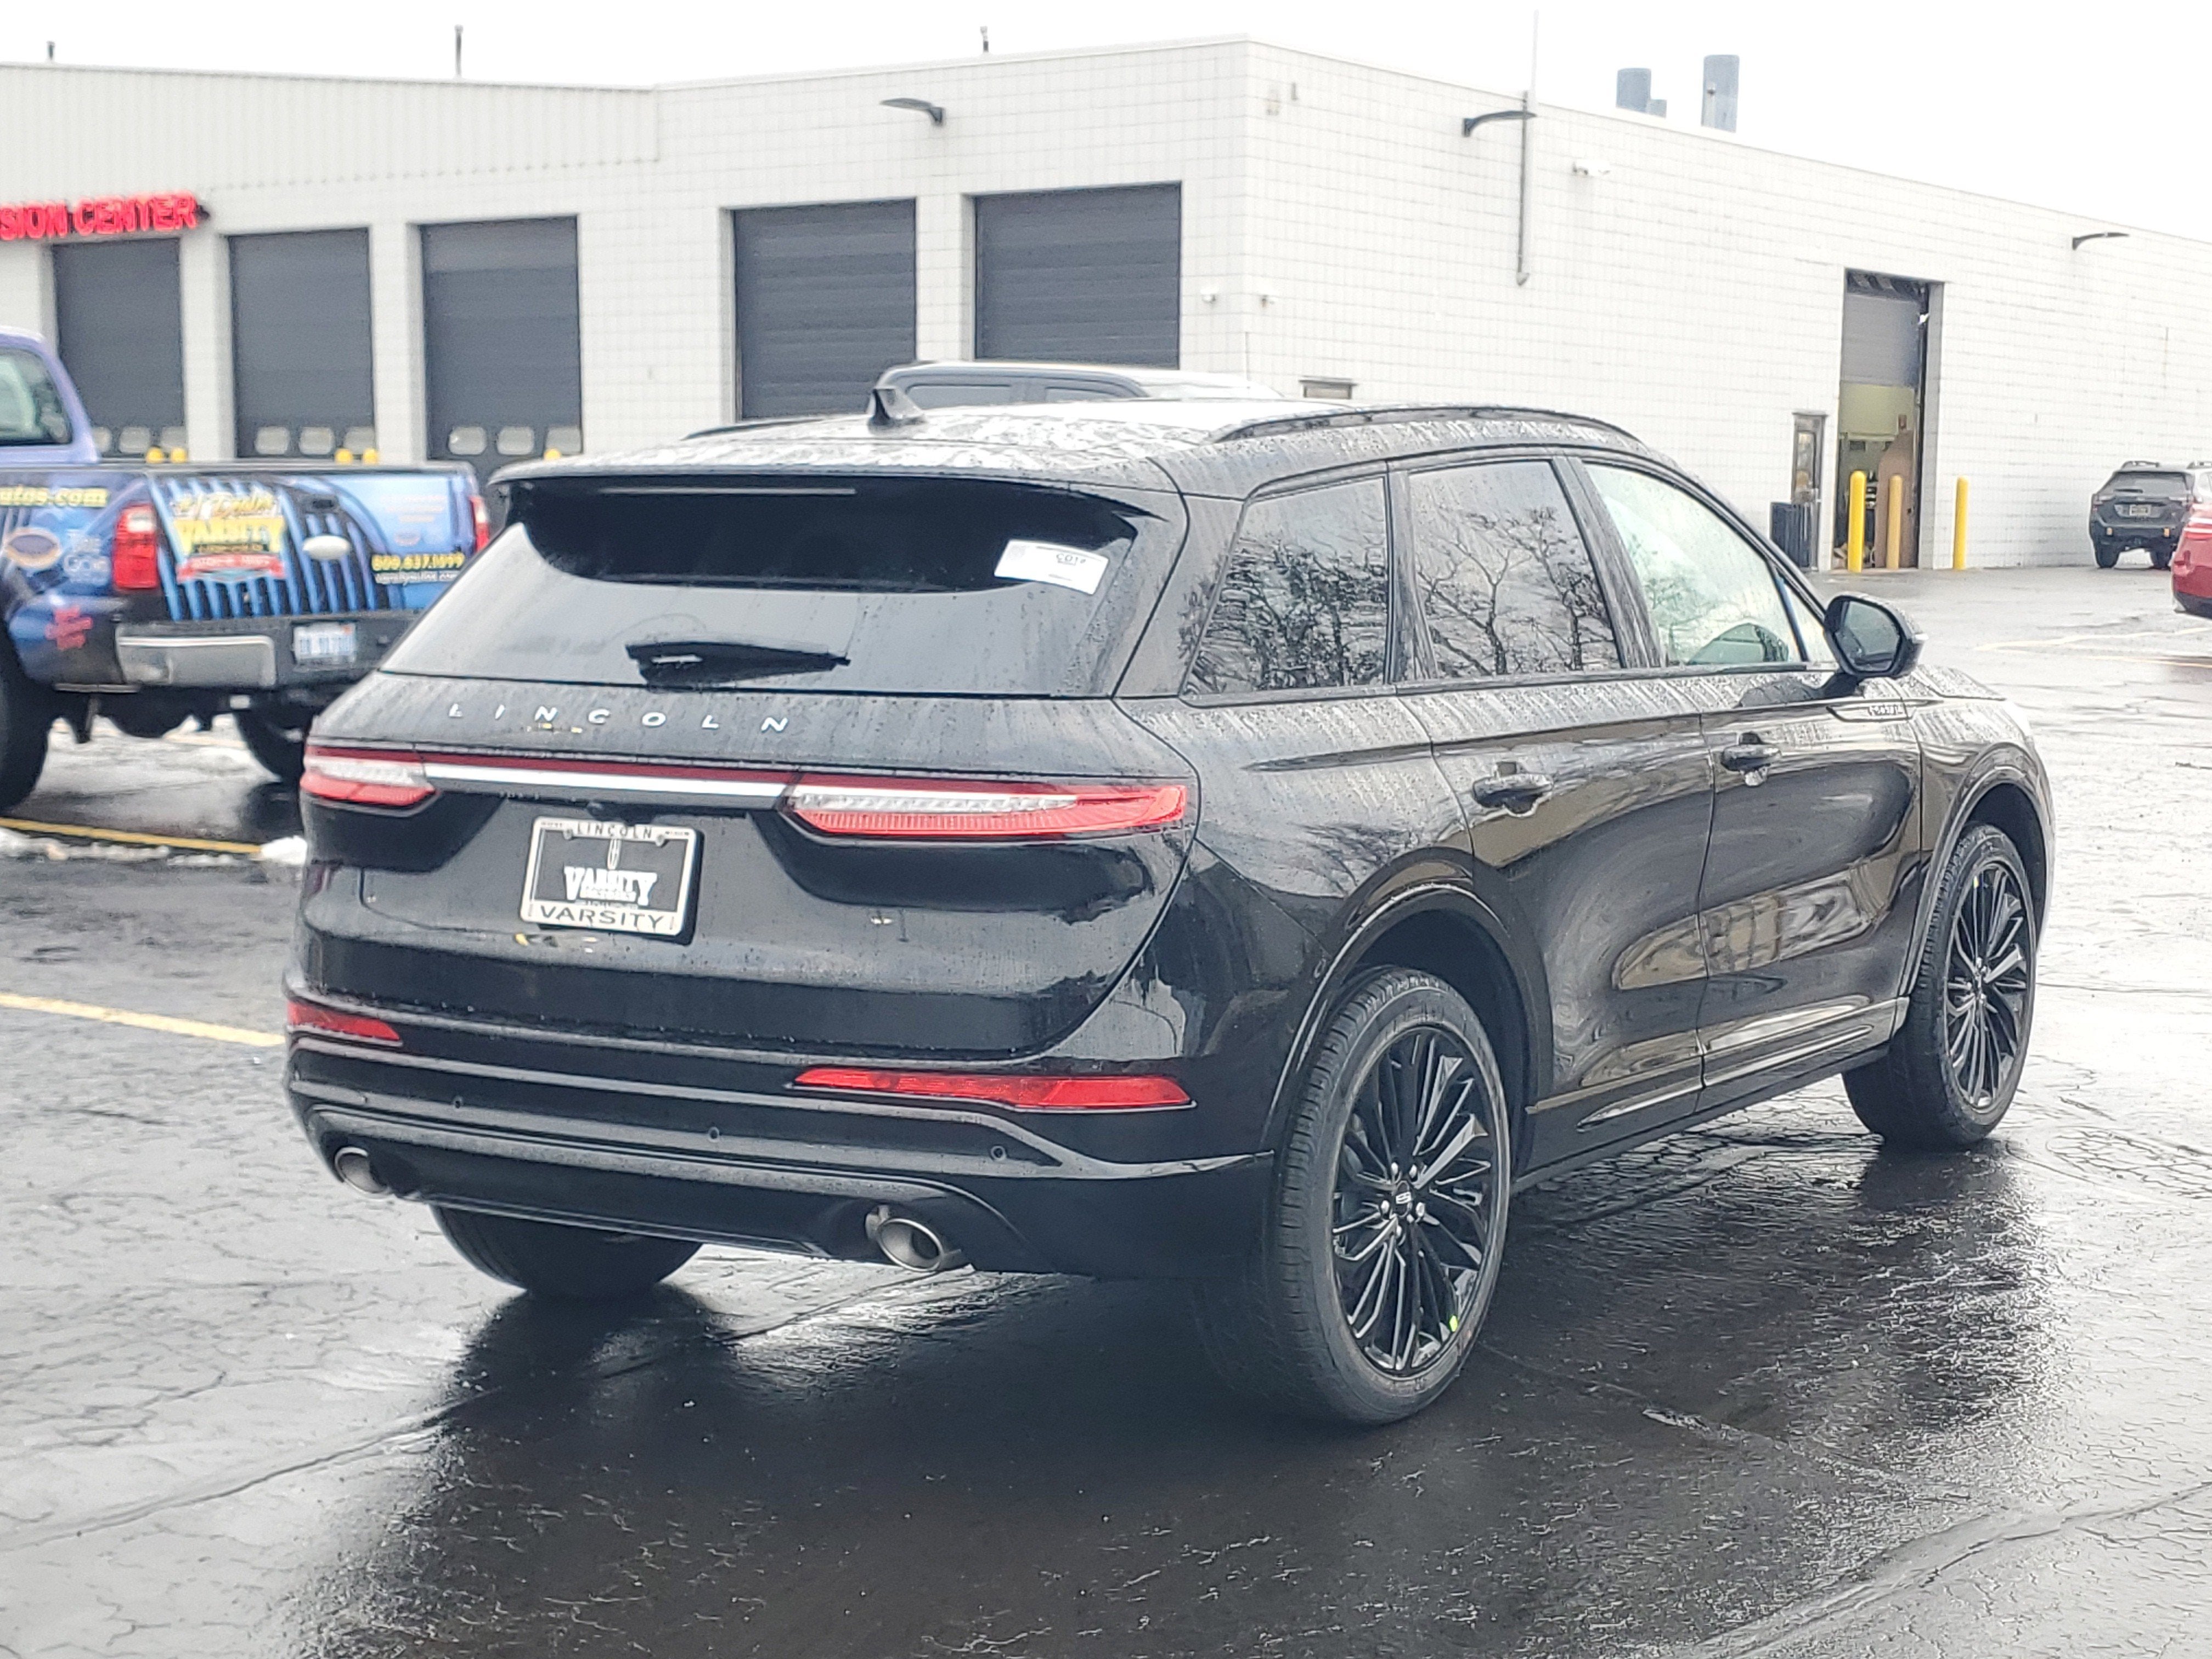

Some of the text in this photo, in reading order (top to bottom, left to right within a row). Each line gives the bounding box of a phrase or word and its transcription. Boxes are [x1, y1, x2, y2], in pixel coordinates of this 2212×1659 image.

[0, 190, 197, 240] SION CENTER
[449, 704, 788, 733] LINCOLN
[577, 823, 653, 839] LINCOLN
[563, 866, 657, 906] VARSITY
[540, 905, 664, 932] VARSITY
